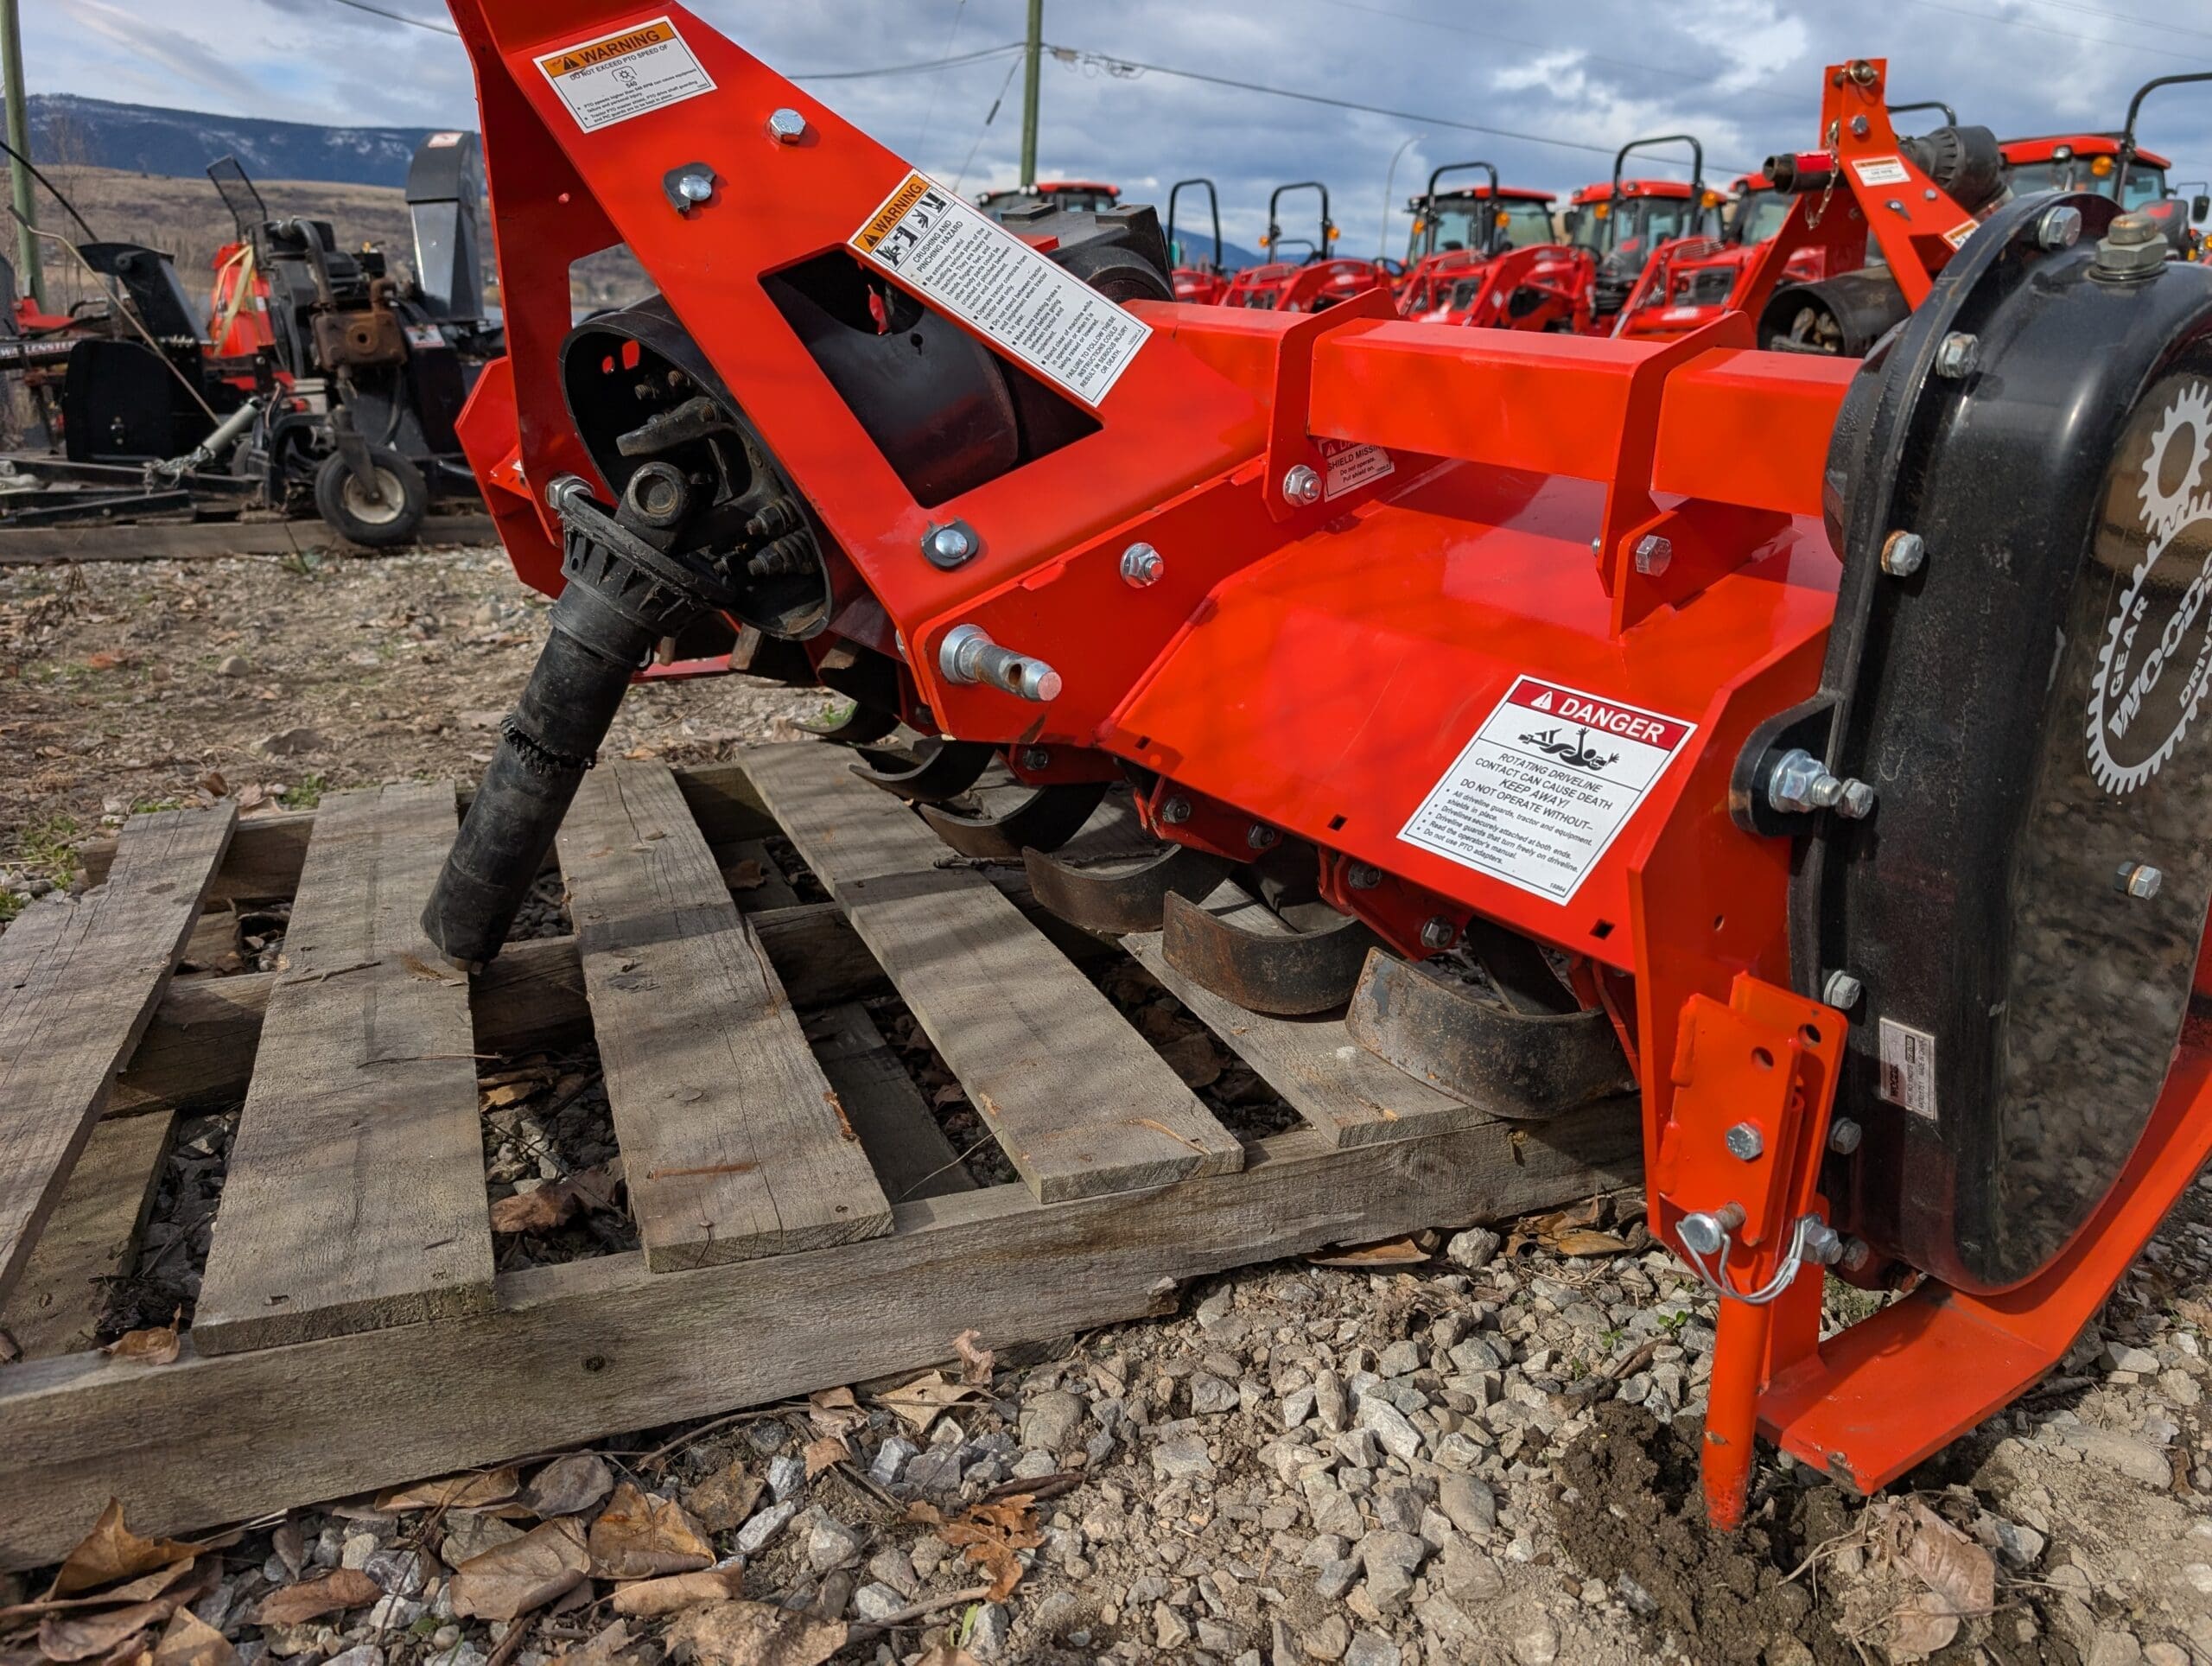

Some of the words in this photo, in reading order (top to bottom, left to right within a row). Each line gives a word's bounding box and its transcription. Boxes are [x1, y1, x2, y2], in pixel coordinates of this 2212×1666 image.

[579, 30, 660, 64] WARNING
[579, 68, 595, 77] NOT
[595, 60, 623, 72] EXCEED
[622, 54, 637, 63] PTO
[637, 48, 658, 58] SPEED
[873, 184, 923, 233] WARNING
[912, 232, 942, 263] CRUSHING
[938, 220, 952, 234] AND
[916, 245, 944, 273] PINCHING
[940, 221, 963, 245] HAZARD
[931, 254, 952, 276] extremely
[950, 238, 964, 255] careful
[931, 267, 952, 287] handling
[949, 251, 965, 268] various
[963, 239, 975, 252] parts
[976, 227, 985, 236] the
[956, 260, 969, 271] They
[971, 239, 986, 253] heavy
[983, 230, 993, 241] and
[958, 265, 976, 281] fingers,
[982, 245, 991, 255] and
[954, 288, 966, 301] other
[963, 277, 976, 289] body
[973, 265, 985, 278] parts
[983, 252, 995, 266] could
[961, 286, 978, 305] crushed
[980, 263, 997, 283] pinched
[994, 246, 1012, 264] between
[967, 294, 982, 310] tractor
[980, 284, 989, 295] and
[987, 263, 1008, 286] implement.
[976, 297, 993, 315] Operate
[990, 283, 1004, 298] tractor
[1003, 265, 1020, 283] controls
[1016, 255, 1027, 266] from
[998, 310, 1007, 320] not
[1004, 297, 1017, 311] stand
[1014, 280, 1031, 299] between
[1029, 265, 1042, 281] tractor
[982, 304, 997, 321] tractor
[995, 295, 1006, 305] seat
[1004, 285, 1014, 296] only.
[1000, 320, 1008, 331] and
[1005, 298, 1027, 322] implement
[1025, 286, 1037, 299] when
[1033, 272, 1048, 287] tractor
[1014, 328, 1027, 341] Make
[1025, 318, 1035, 329] sure
[1033, 302, 1049, 320] parking
[1045, 289, 1058, 302] brake
[1044, 346, 1058, 361] Stand
[1055, 335, 1065, 347] clear
[1068, 312, 1084, 331] machine
[1083, 300, 1093, 312] while
[1056, 339, 1073, 360] operation
[1076, 321, 1088, 334] when
[1058, 356, 1071, 370] being
[1068, 341, 1081, 357] raised
[1083, 319, 1099, 337] lowered.
[1065, 358, 1084, 379] FAILURE
[1086, 330, 1104, 352] FOLLOW
[1101, 315, 1116, 332] THESE
[1077, 342, 1106, 378] INSTRUCTIONS
[1103, 326, 1118, 343] COULD
[1079, 367, 1096, 388] RESULT
[1098, 341, 1116, 363] SERIOUS
[1114, 325, 1128, 343] INJURY
[1100, 365, 1109, 374] OR
[1106, 349, 1122, 366] DEATH.
[1327, 454, 1354, 472] SHIELD
[1352, 468, 1366, 479] shield
[2109, 596, 2149, 697] GEAR
[1558, 698, 1665, 743] DANGER
[1475, 758, 1521, 778] CONTACT
[1520, 773, 1542, 785] CAN
[1541, 780, 1578, 798] CAUSE
[1576, 792, 1613, 810] DEATH
[1498, 753, 1549, 774] ROTATING
[1548, 769, 1603, 792] DRIVELINE
[1498, 779, 1531, 793] KEEP
[1529, 790, 1570, 808] AWAY!
[1446, 799, 1470, 811] shields
[1478, 811, 1497, 821] place.
[1460, 779, 1476, 789] DO
[1475, 784, 1497, 796] NOT
[1497, 792, 1543, 813] OPERATE
[1462, 794, 1491, 808] driveline
[1490, 805, 1514, 818] guards,
[1516, 814, 1540, 826] tractor
[1423, 828, 1433, 836] Do
[1458, 842, 1474, 852] PTO
[1473, 849, 1503, 864] adapters.
[1429, 820, 1447, 831] Read
[1491, 846, 1516, 859] manual.
[1435, 812, 1463, 828] Driveline
[1462, 825, 1486, 836] guards
[1486, 833, 1501, 843] that
[1501, 838, 1516, 848] turn
[1516, 844, 1536, 856] freely
[1547, 856, 1578, 873] driveline.
[1440, 805, 1472, 822] Drivelines
[1471, 818, 1499, 832] securely
[1498, 828, 1529, 843] attached
[1535, 841, 1552, 851] both
[1553, 849, 1571, 860] ends.
